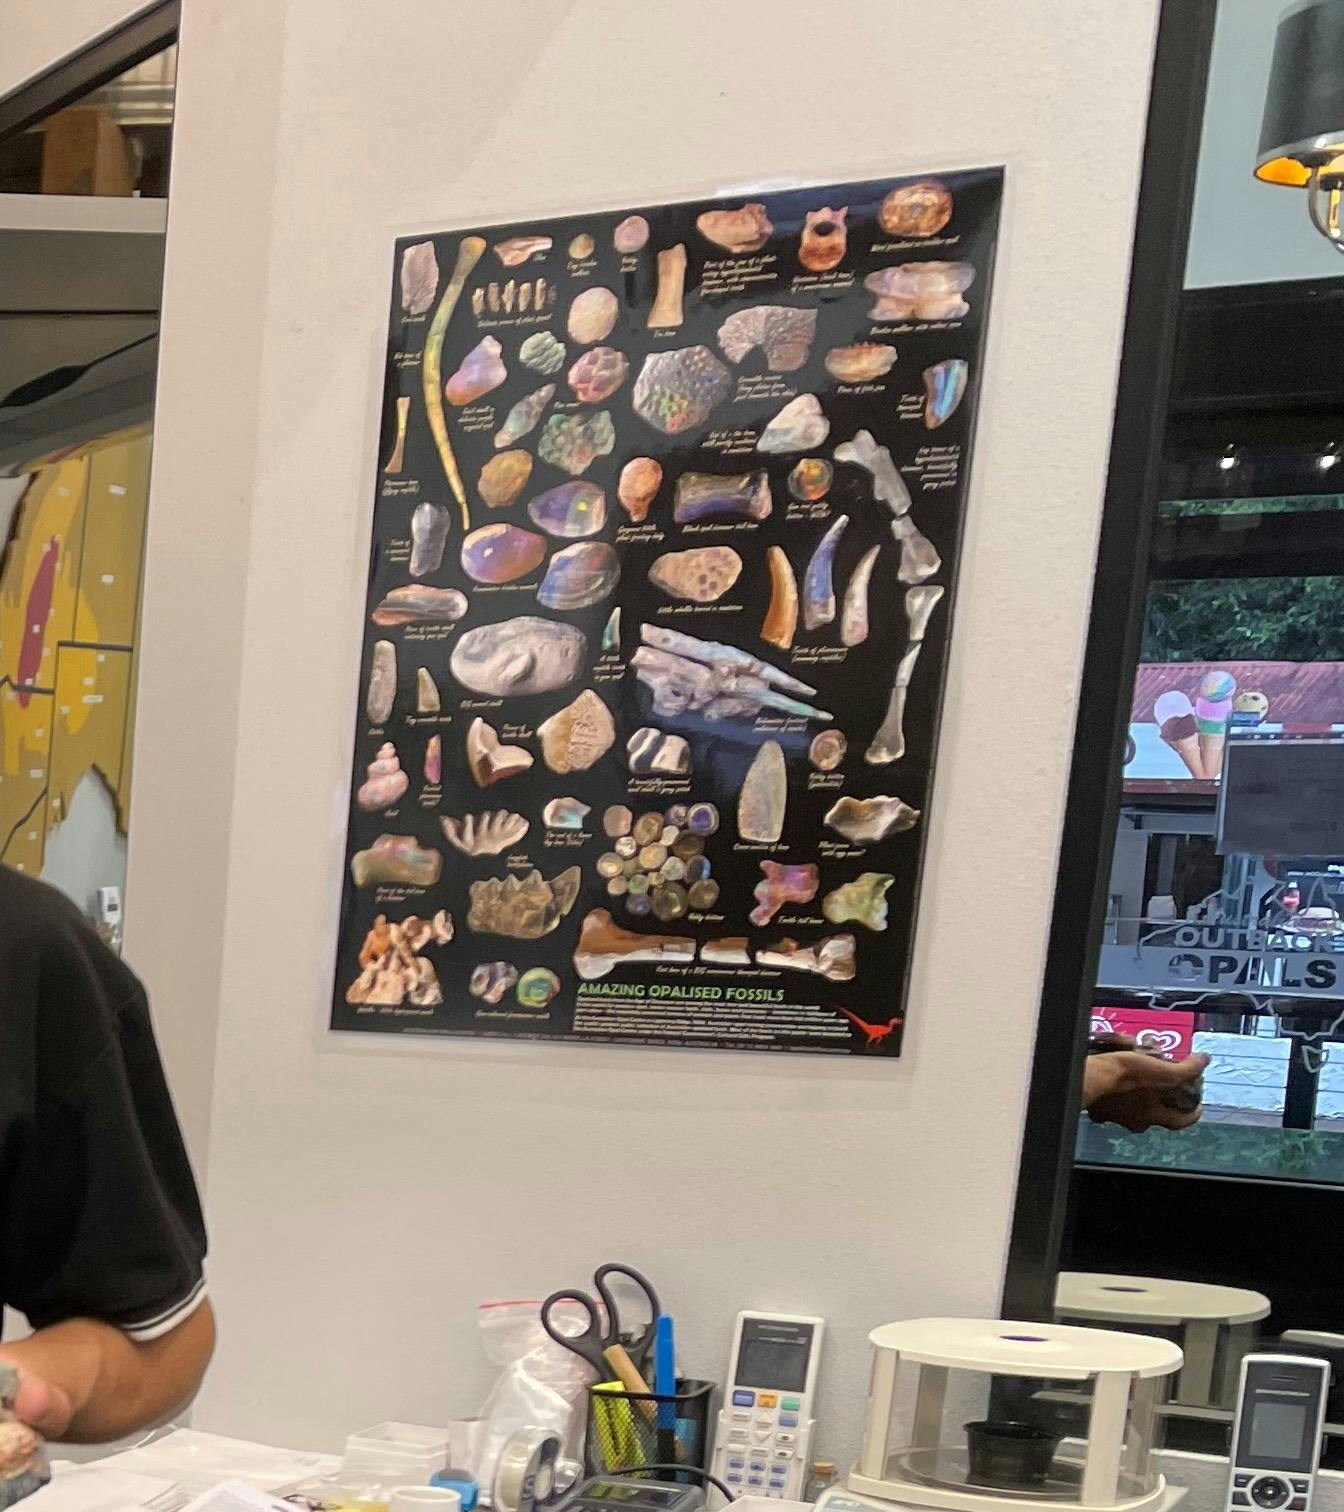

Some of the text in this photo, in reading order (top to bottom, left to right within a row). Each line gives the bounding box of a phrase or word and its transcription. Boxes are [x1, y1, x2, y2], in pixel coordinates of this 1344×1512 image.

[1168, 953, 1337, 989] OPALS
[578, 982, 785, 1001] AMAZING OPALISED FOSSILS
